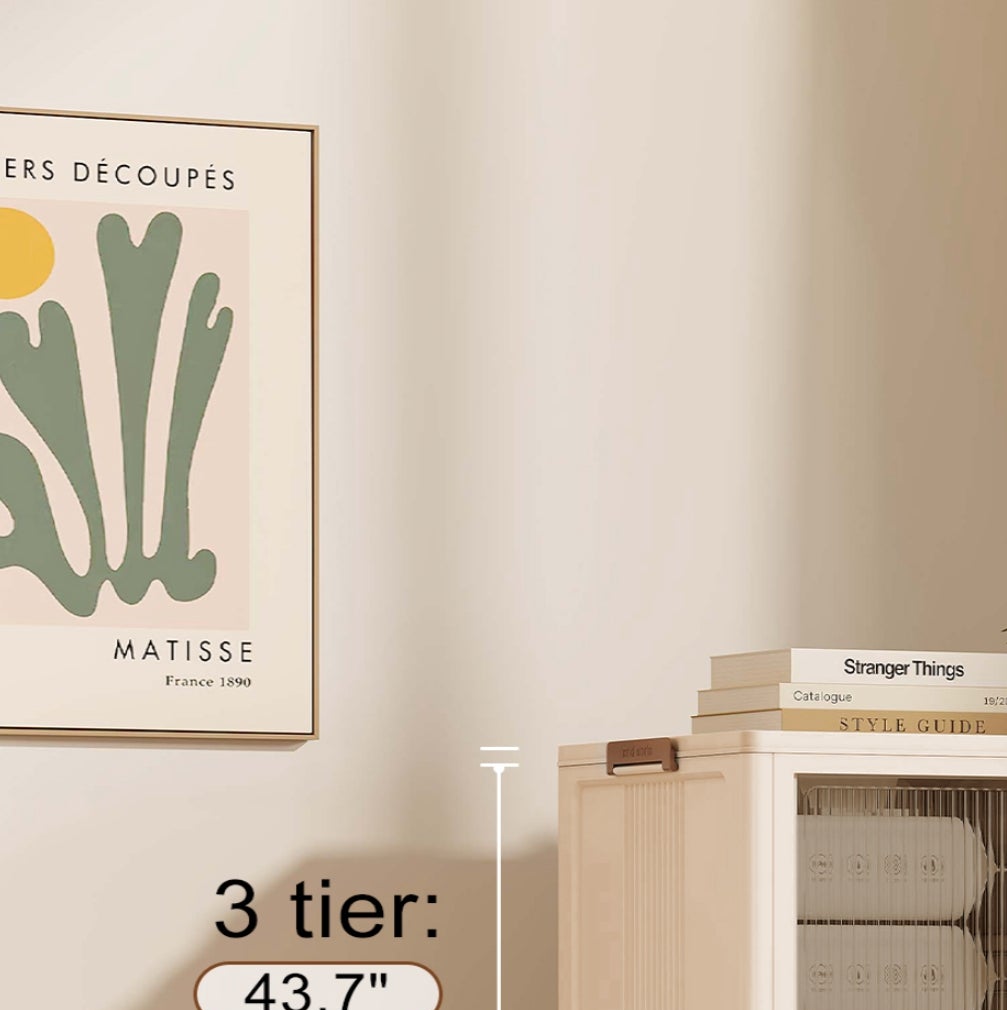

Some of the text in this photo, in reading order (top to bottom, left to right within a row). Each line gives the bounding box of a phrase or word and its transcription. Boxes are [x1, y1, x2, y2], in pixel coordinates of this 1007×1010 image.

[5, 158, 236, 191] ERS DÉCOUPÉS
[114, 639, 253, 663] MATISSE
[844, 657, 965, 681] Stranger Things
[165, 675, 252, 688] France 1890
[793, 690, 853, 704] Catalogue
[840, 716, 986, 735] STYLE GUIDE
